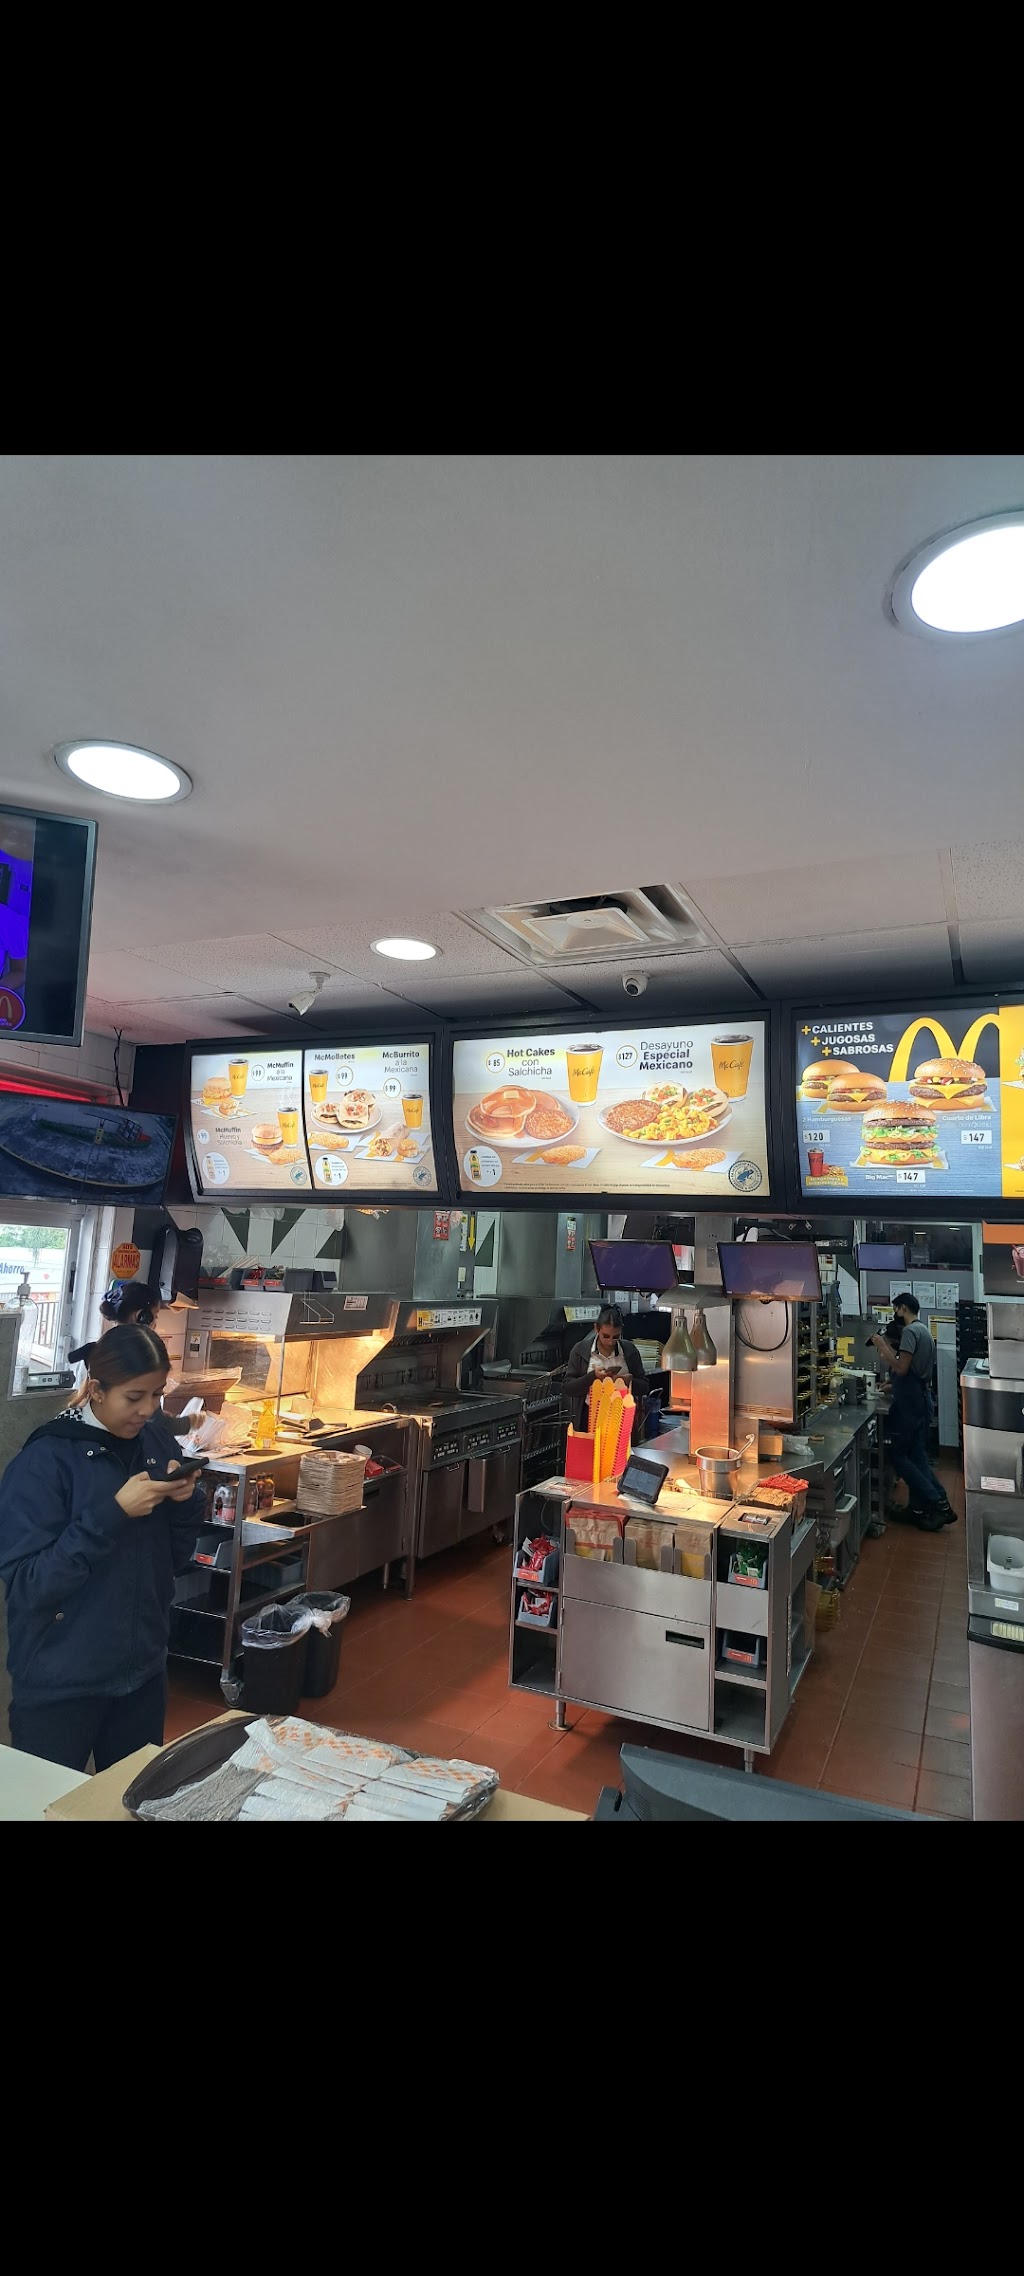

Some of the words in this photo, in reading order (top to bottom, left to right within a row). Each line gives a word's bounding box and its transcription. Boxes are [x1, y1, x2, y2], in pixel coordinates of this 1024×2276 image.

[640, 1040, 694, 1052] Desayuno
[314, 1053, 356, 1061] McMolletes
[382, 1050, 420, 1059] McBurrito
[507, 1049, 524, 1058] Hot
[526, 1048, 556, 1057] Cakes
[643, 1049, 690, 1062] Especial
[266, 1061, 294, 1069] McMuffin
[521, 1059, 540, 1067] con
[639, 1060, 693, 1071] Mexicano
[508, 1067, 553, 1077] Salchicha
